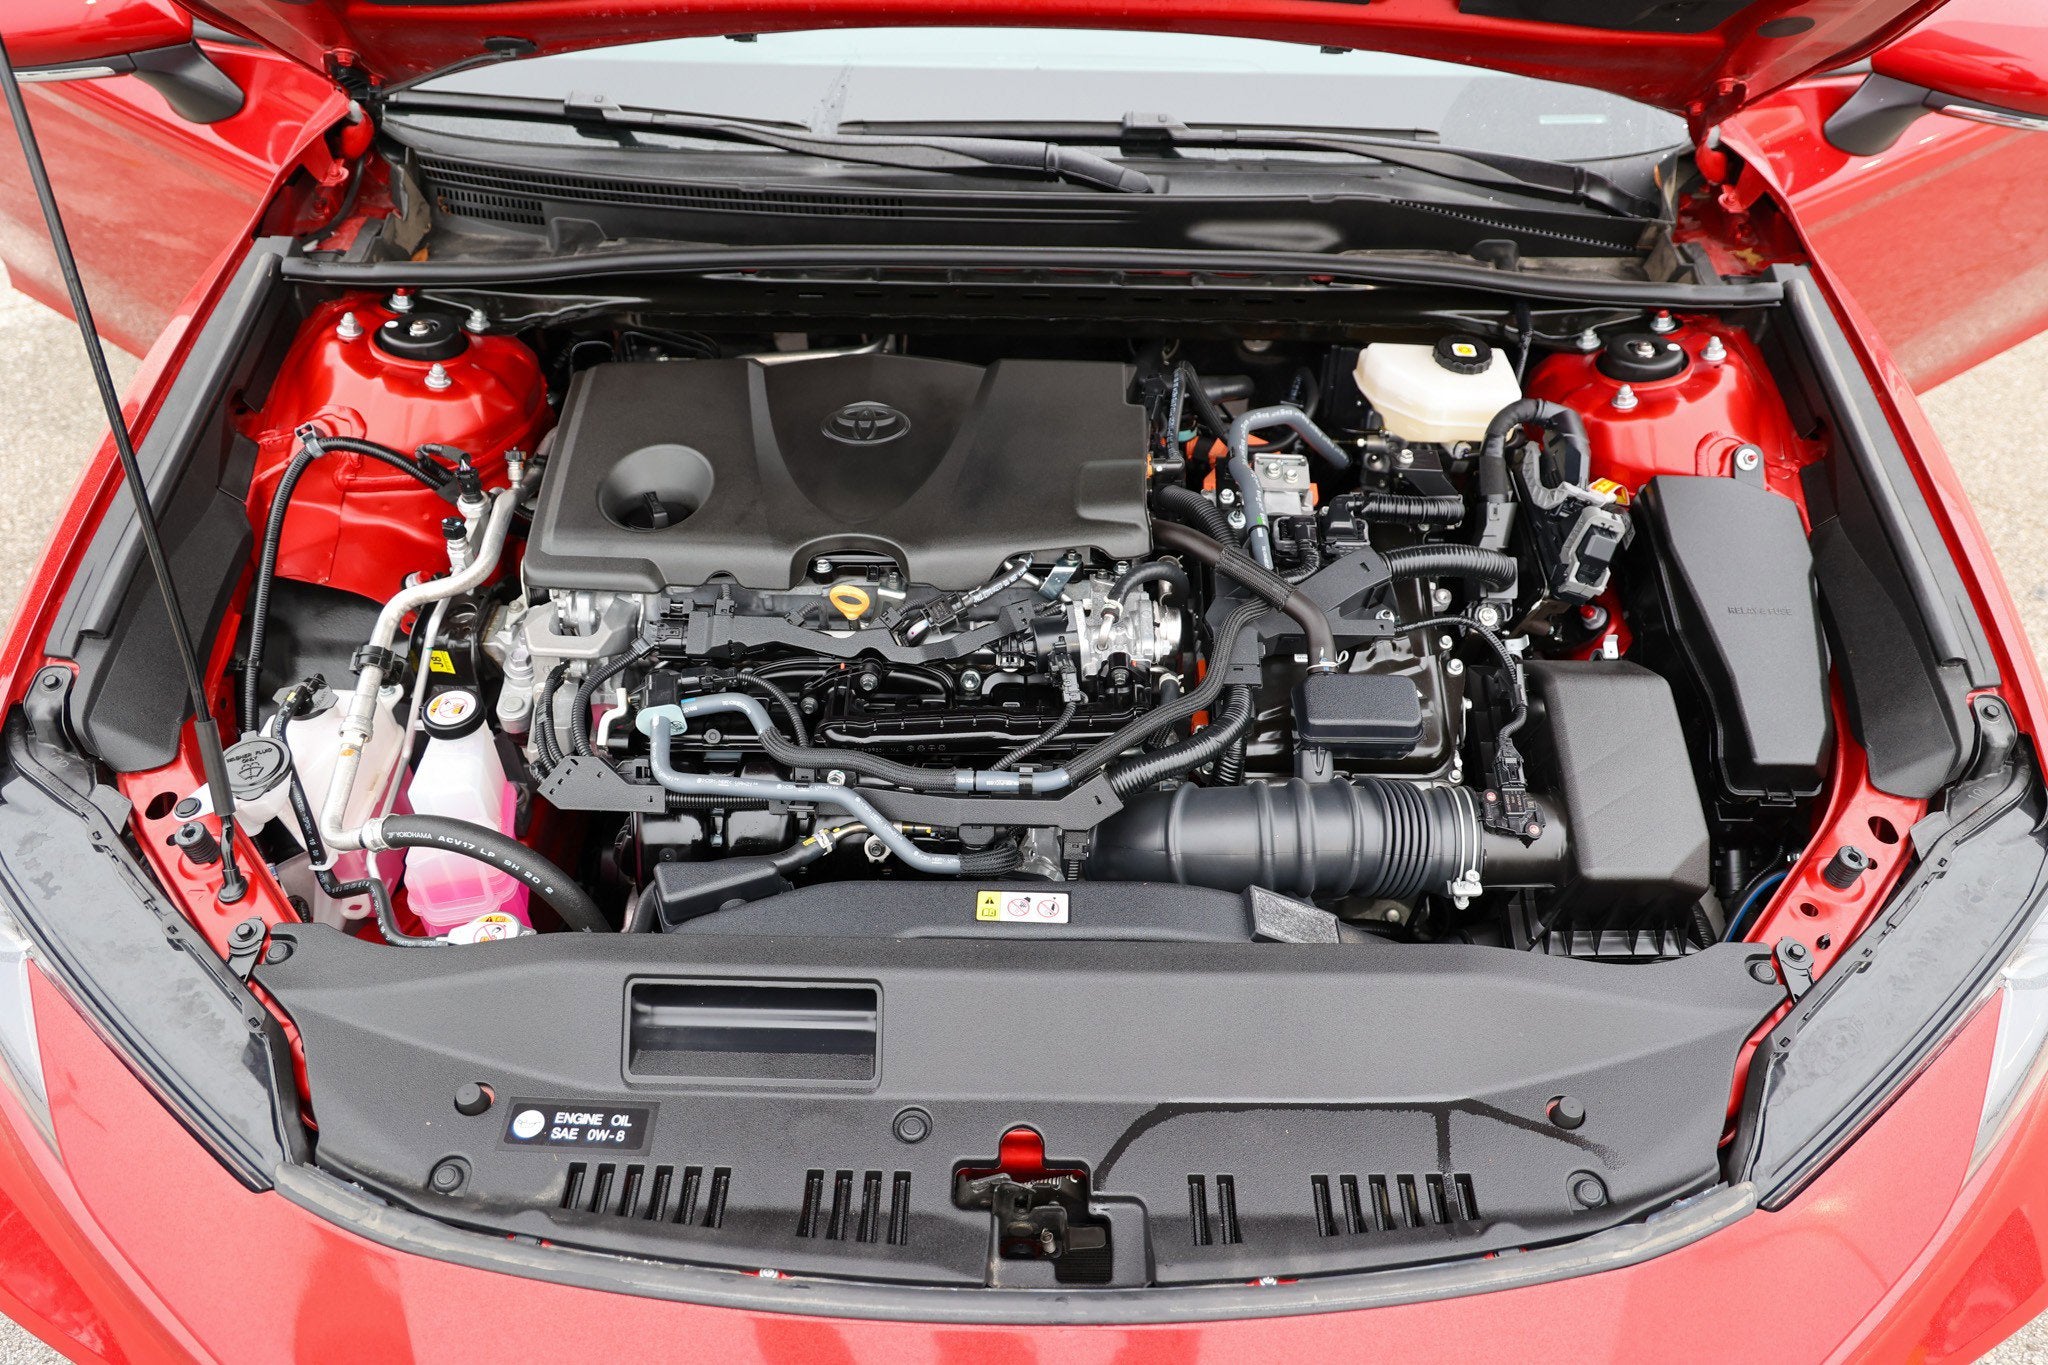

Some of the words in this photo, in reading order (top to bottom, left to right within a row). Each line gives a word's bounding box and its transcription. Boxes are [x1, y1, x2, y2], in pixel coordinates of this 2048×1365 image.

[1727, 606, 1757, 615] RELAY
[1768, 607, 1793, 616] FUSE
[255, 747, 273, 755] FLUID
[396, 831, 433, 840] YOKOHAMA
[438, 835, 476, 850] ACV17
[479, 848, 496, 858] LP
[524, 871, 541, 884] 20
[545, 886, 554, 895] 2
[554, 1111, 604, 1126] ENGINE
[611, 1114, 632, 1127] OIL
[550, 1127, 580, 1140] SAE
[587, 1129, 626, 1142] 0W-8
